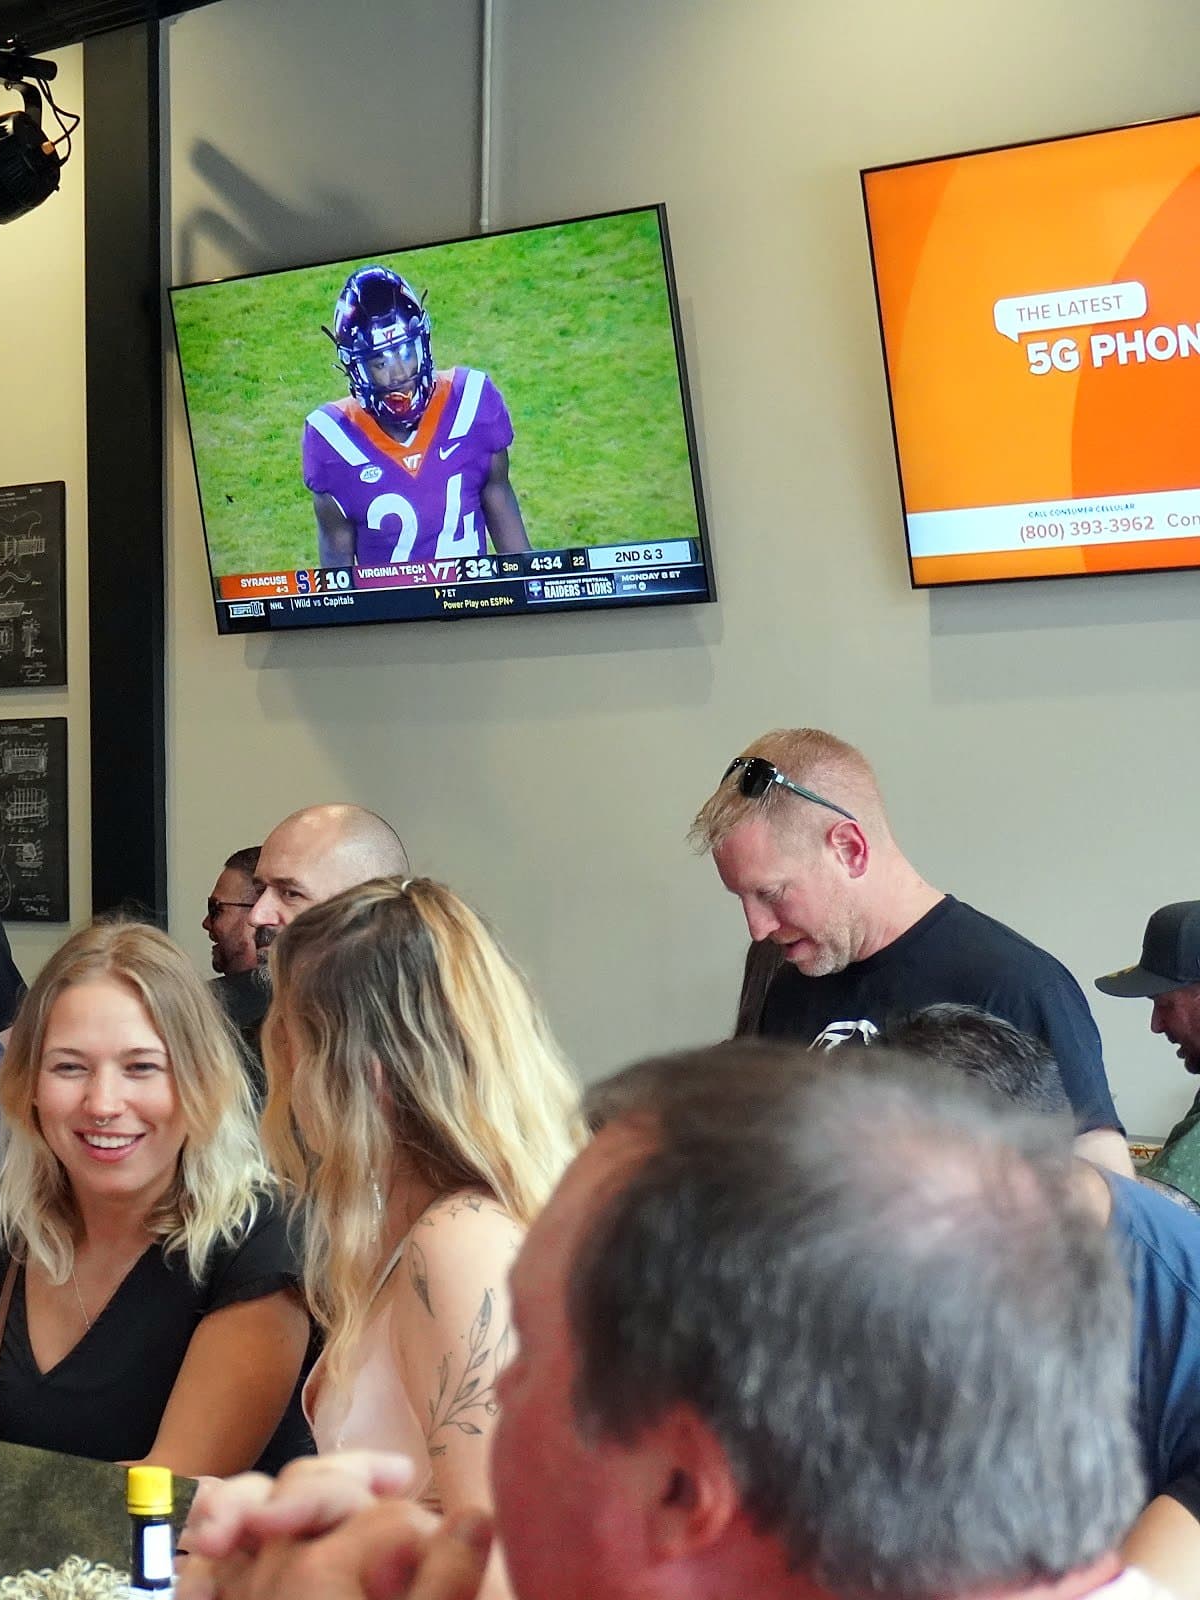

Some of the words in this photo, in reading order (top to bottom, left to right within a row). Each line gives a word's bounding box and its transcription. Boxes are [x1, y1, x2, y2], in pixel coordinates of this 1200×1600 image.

[1016, 304, 1051, 322] THE
[1057, 295, 1123, 317] LATEST
[1026, 338, 1080, 375] 5G
[1090, 322, 1200, 368] PHON
[366, 473, 481, 565] 24
[1028, 511, 1047, 519] CALL
[1049, 506, 1093, 517] CONSUMER
[1095, 503, 1136, 513] CELLULAR
[1020, 523, 1065, 543] (800)
[1070, 516, 1155, 537] 393-3962
[502, 562, 518, 572] 3RD
[531, 556, 562, 570] 4:34
[573, 556, 585, 566] 22
[615, 551, 639, 563] 2ND
[643, 549, 653, 560] &
[655, 549, 664, 560] 3
[358, 566, 398, 579] VIRGINIA
[399, 564, 426, 576] TECH
[428, 561, 456, 580] VT
[465, 559, 492, 577] 32
[622, 572, 660, 581] MONDAY
[669, 570, 681, 579] ET
[240, 575, 288, 588] SYRACUSE
[326, 571, 349, 590] 10
[447, 588, 456, 597] ET
[544, 583, 580, 598] RAIDERS
[586, 581, 613, 595] LIONS
[270, 601, 284, 610] NHL
[295, 599, 311, 608] Wild
[323, 596, 355, 607] Capitals
[443, 600, 464, 609] Power
[464, 599, 478, 609] Play
[490, 596, 514, 606] ESPN+
